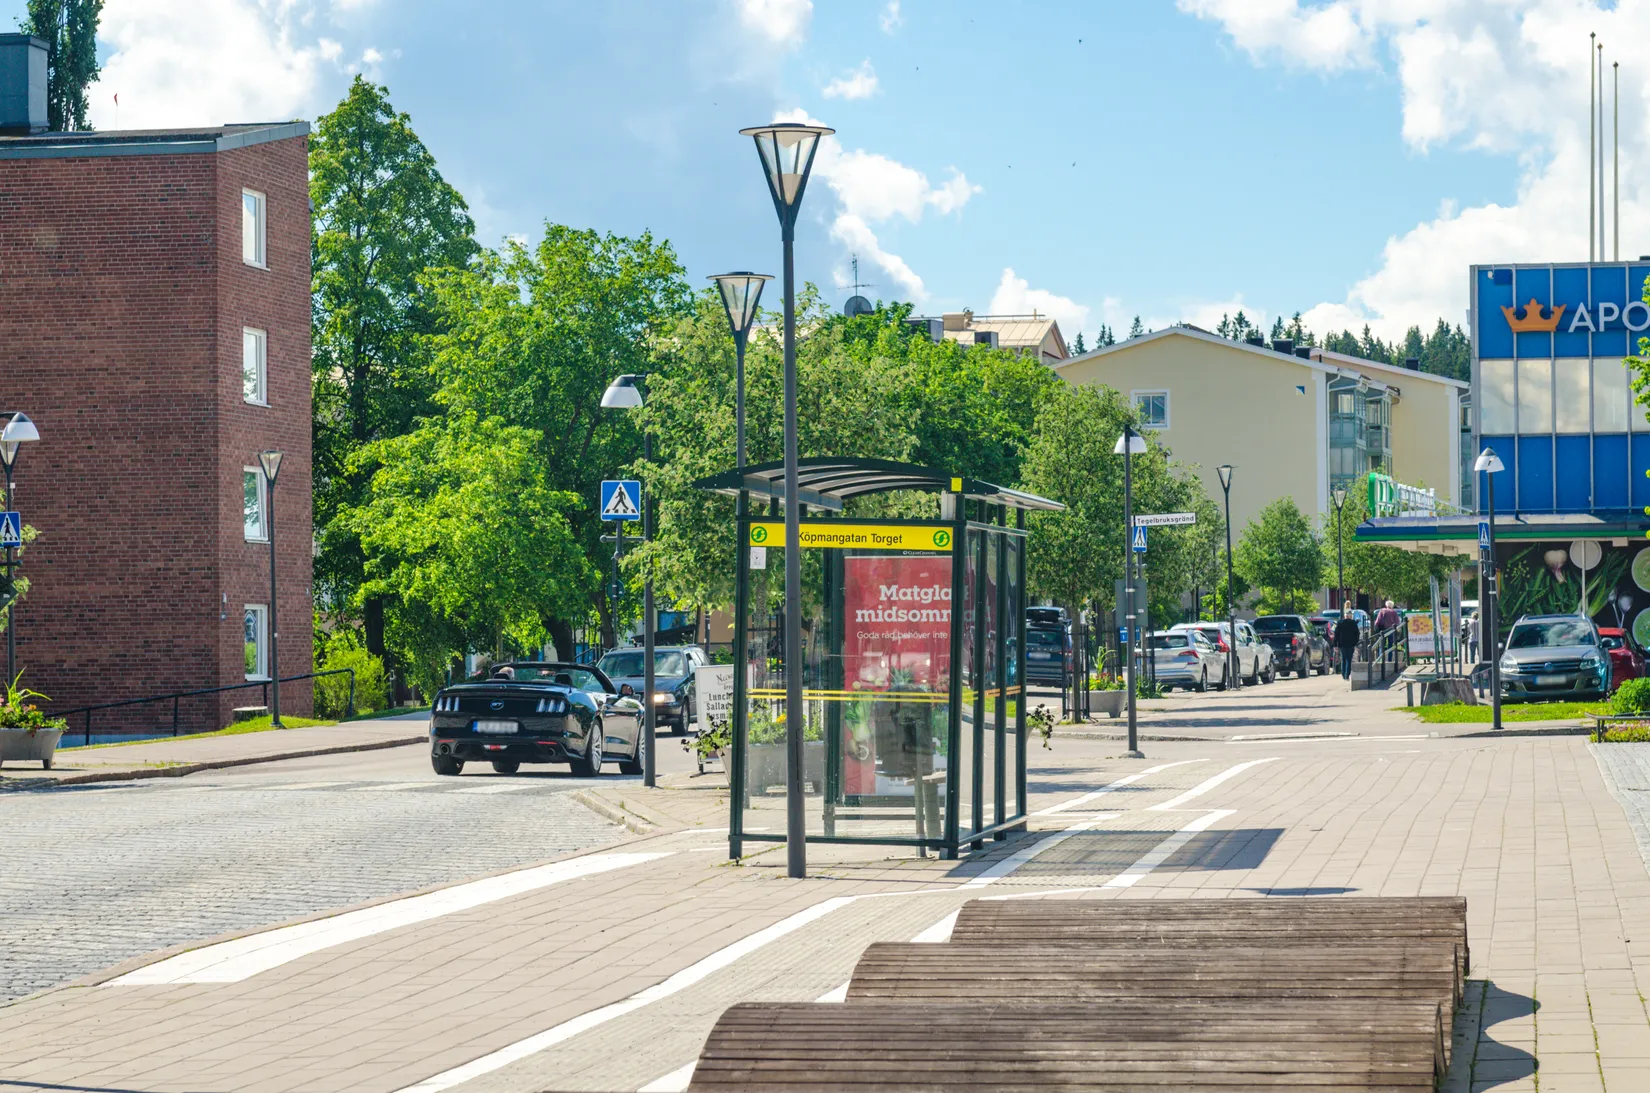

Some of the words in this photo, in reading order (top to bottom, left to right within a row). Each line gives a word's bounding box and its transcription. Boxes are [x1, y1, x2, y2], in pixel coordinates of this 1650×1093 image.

[1568, 301, 1650, 332] APO
[1137, 516, 1194, 525] Tegelbruksgränd
[799, 532, 867, 544] Köpmangatan
[871, 533, 902, 545] Torget
[879, 584, 952, 604] Matgla
[857, 631, 880, 639] Goda
[897, 630, 930, 639] behöver
[933, 630, 948, 639] inte
